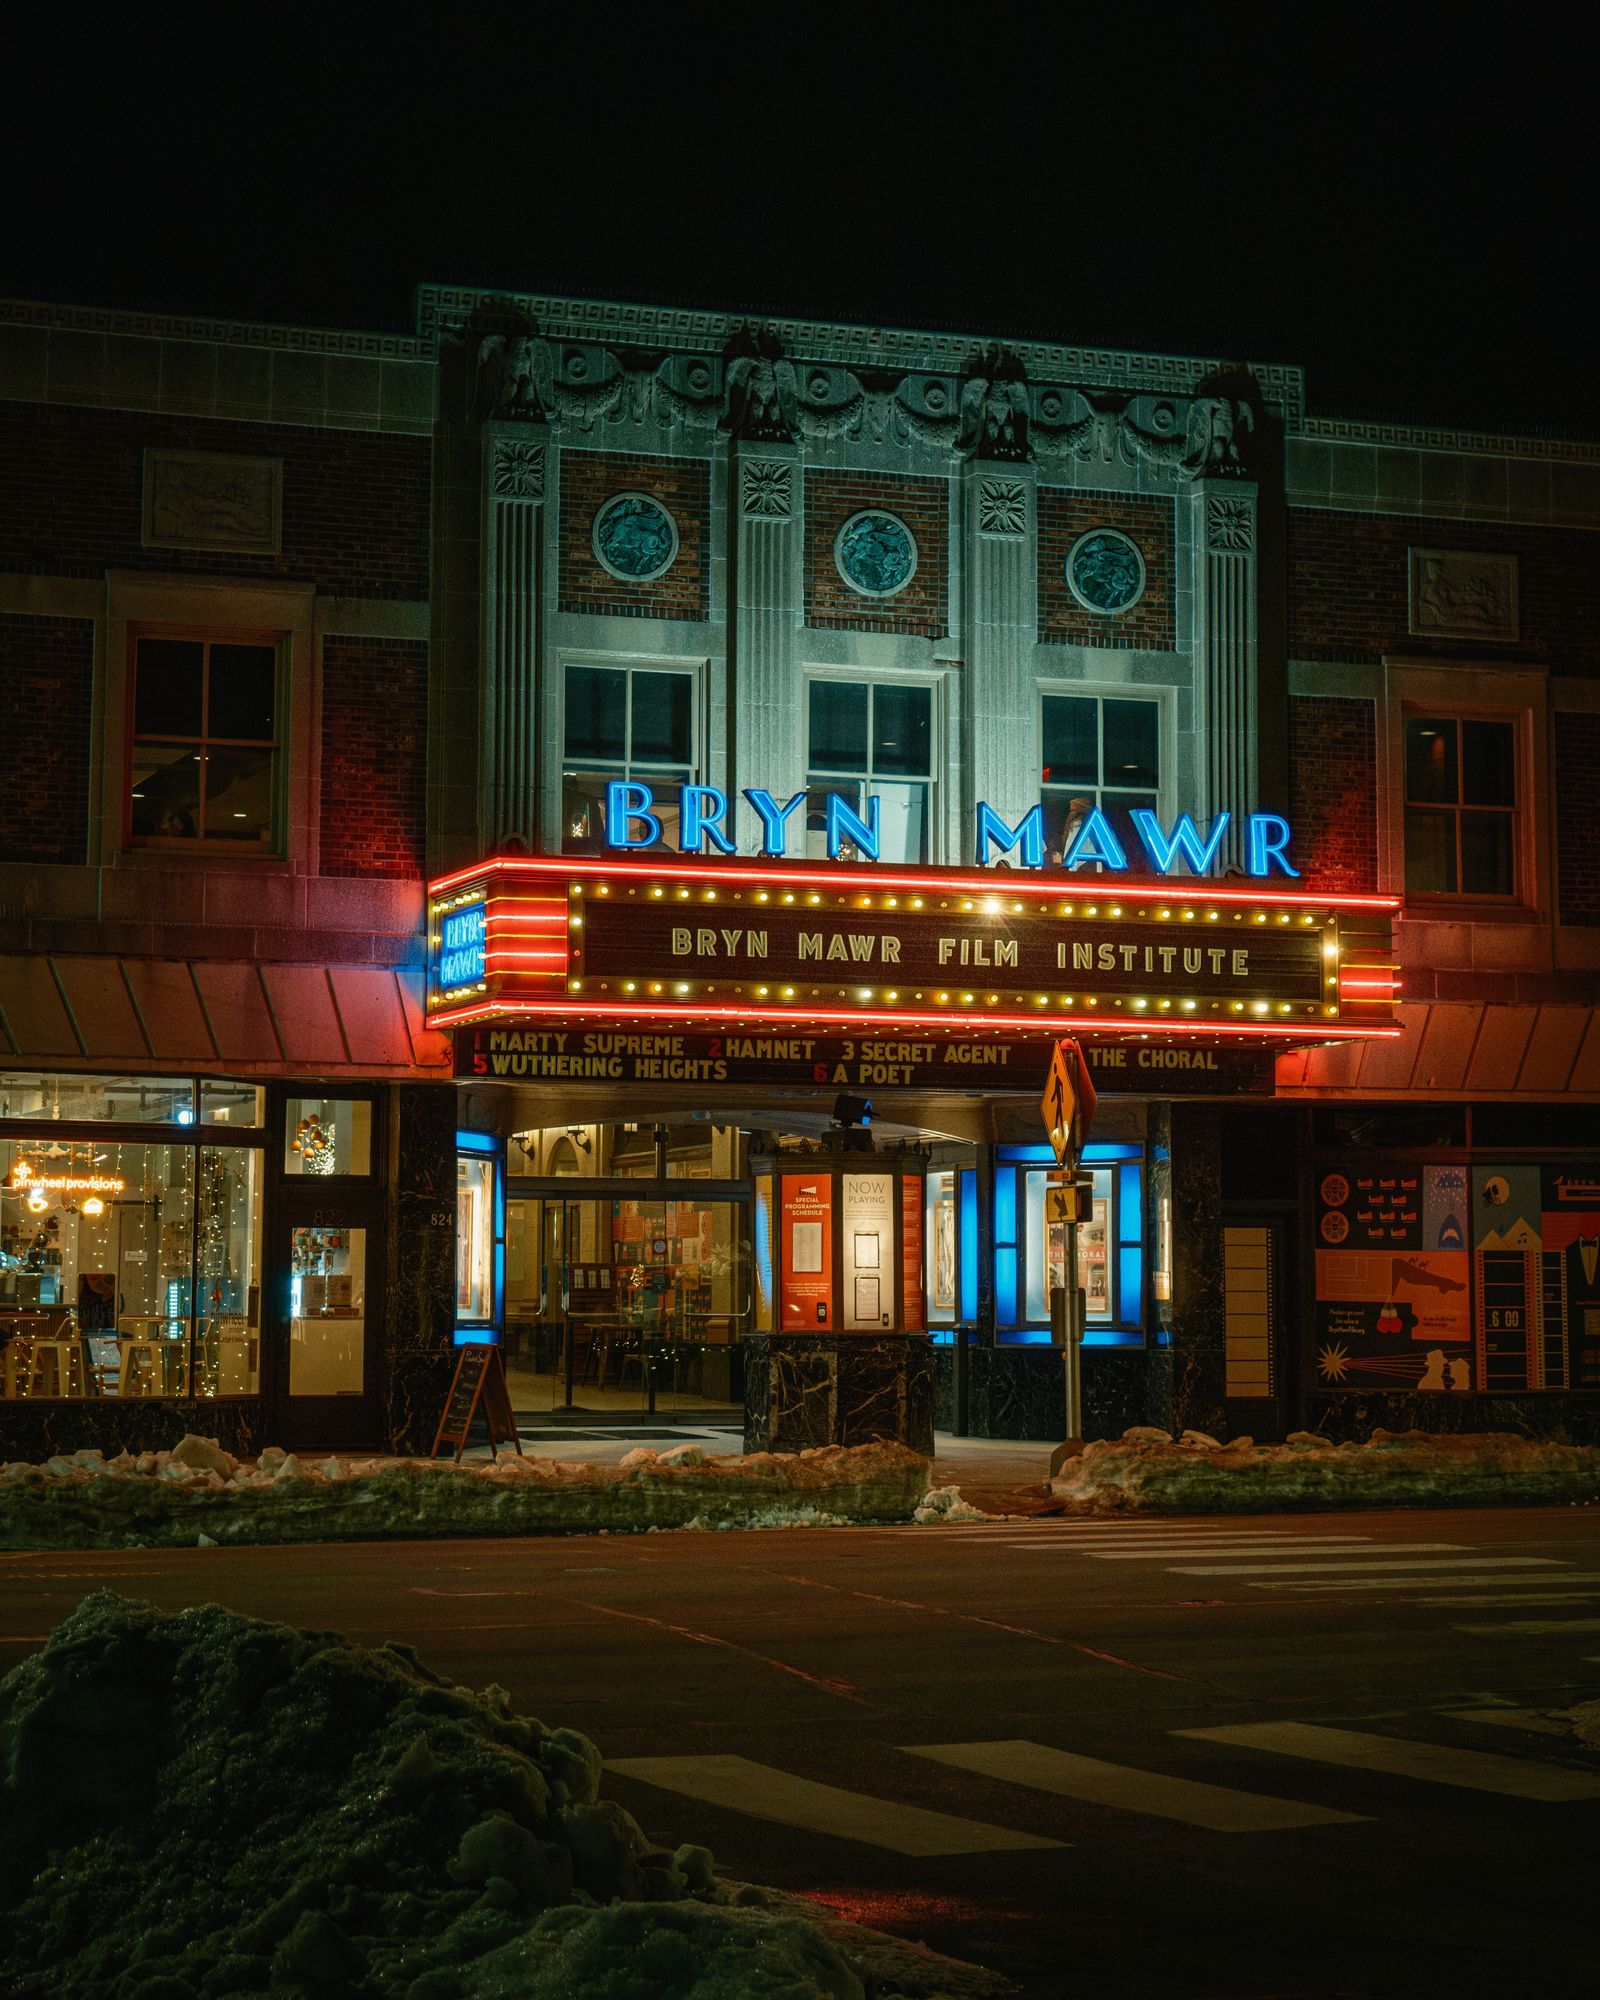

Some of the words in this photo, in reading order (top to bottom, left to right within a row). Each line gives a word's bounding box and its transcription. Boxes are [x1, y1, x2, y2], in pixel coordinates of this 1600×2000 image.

[605, 781, 880, 860] BRYN
[976, 800, 1300, 877] MAWR
[672, 927, 768, 958] BRYN
[798, 932, 901, 963] MAWR
[938, 938, 1018, 967] FILM
[1057, 942, 1249, 976] INSTITUTE
[490, 1031, 568, 1053] MARTY
[583, 1033, 684, 1056] SUPREME
[709, 1038, 722, 1057] 2
[725, 1038, 816, 1060] HAMNET
[841, 1040, 855, 1061] 3
[861, 1041, 936, 1063] SECRET
[944, 1044, 1012, 1065] AGENT
[1088, 1047, 1127, 1067] THE
[1138, 1049, 1218, 1070] CHORAL
[473, 1053, 488, 1074] 5
[491, 1054, 624, 1077] WUTHERING
[635, 1058, 728, 1080] HEIGHTS
[814, 1062, 828, 1083] 6
[832, 1063, 849, 1083] A
[859, 1063, 915, 1085] POET
[13, 1176, 65, 1189] pinwheel
[66, 1176, 123, 1190] provisions
[848, 1182, 885, 1194] NOW
[848, 1196, 885, 1204] PLAYING
[430, 1213, 453, 1226] 824
